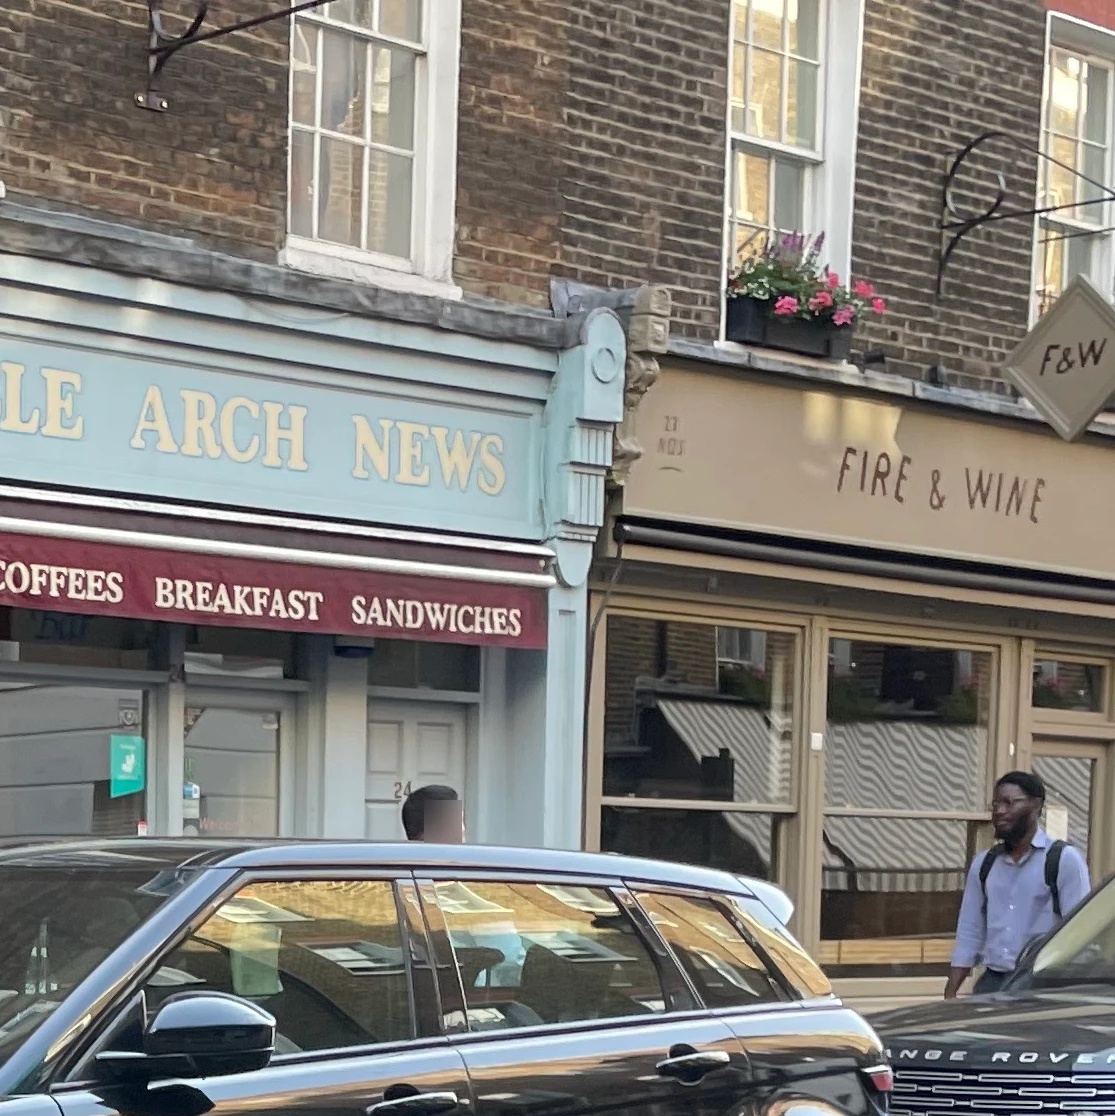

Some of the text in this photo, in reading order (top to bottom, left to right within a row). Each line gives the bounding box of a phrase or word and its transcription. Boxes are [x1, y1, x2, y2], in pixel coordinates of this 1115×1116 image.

[1039, 337, 1108, 376] F&W
[129, 384, 310, 472] ARCH
[351, 413, 507, 496] NEWS
[837, 446, 1046, 524] FIRE & WINE
[154, 576, 324, 621] BREAKFAST
[351, 596, 522, 637] SANDWICHES
[394, 781, 412, 798] 24
